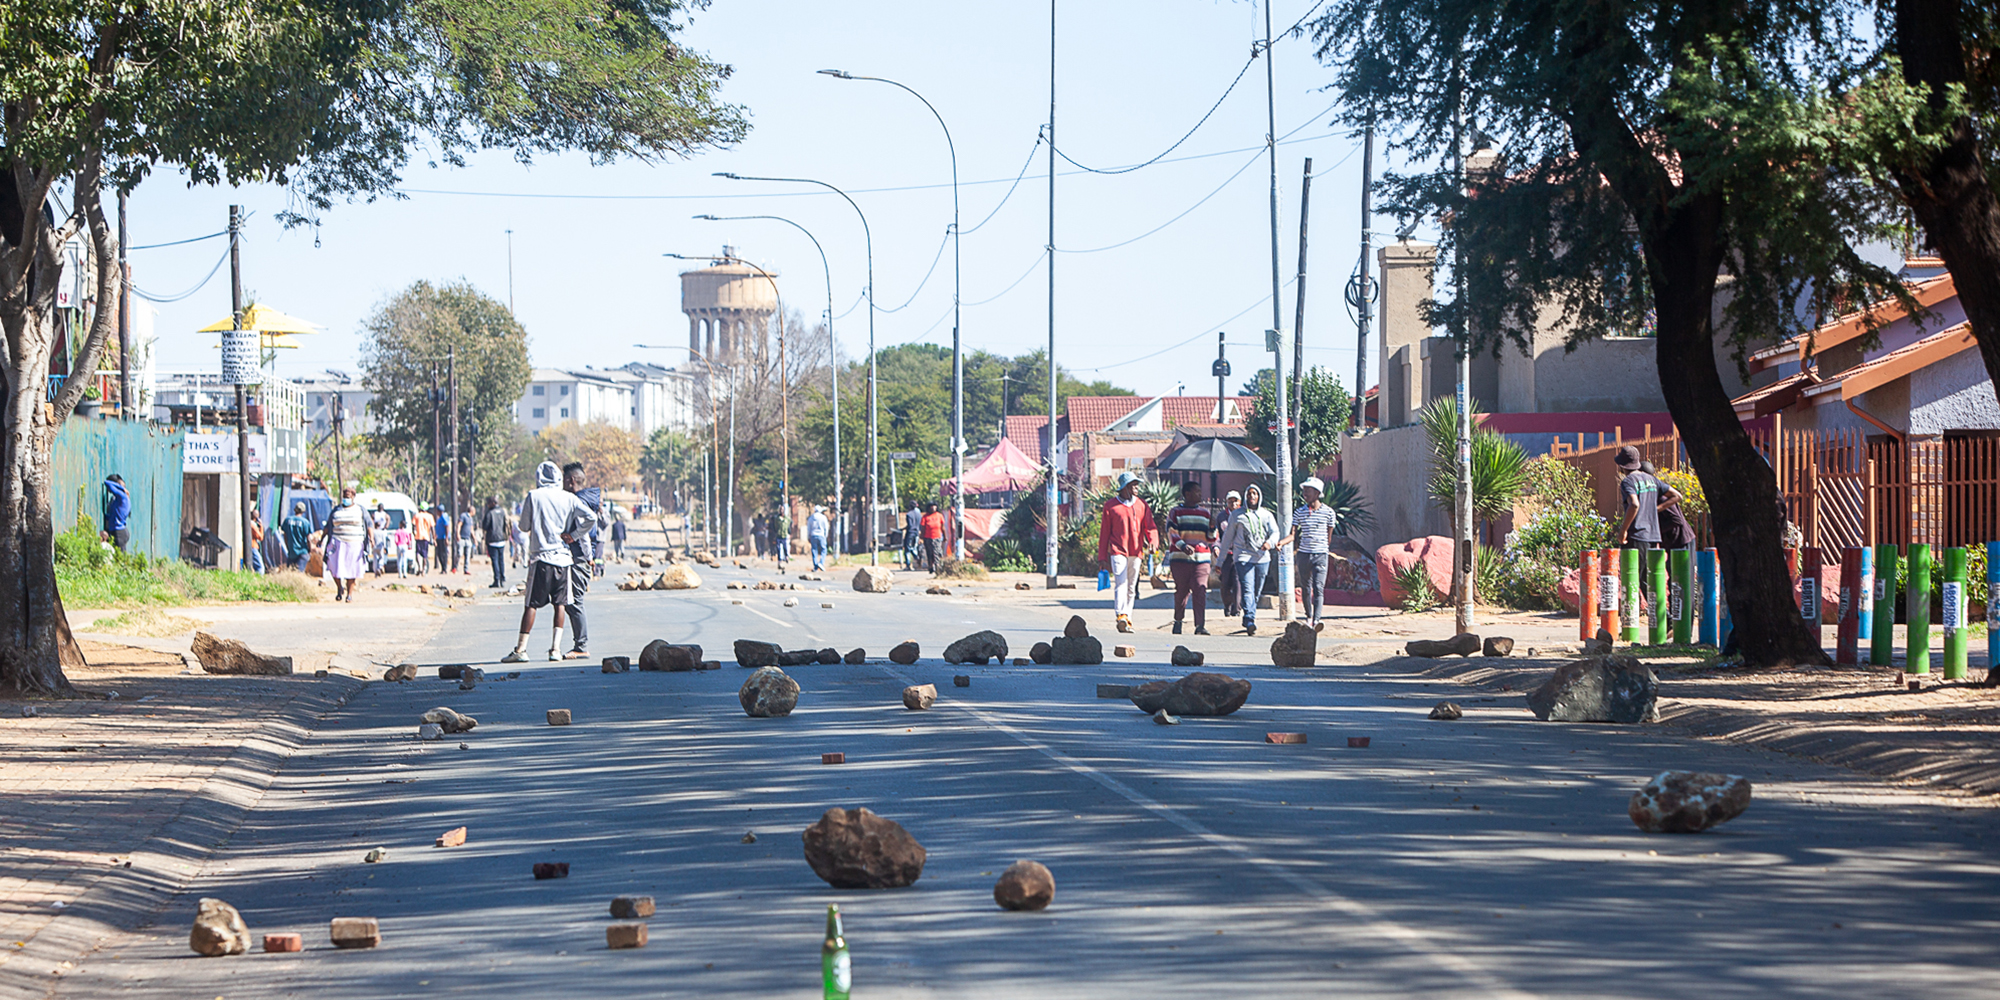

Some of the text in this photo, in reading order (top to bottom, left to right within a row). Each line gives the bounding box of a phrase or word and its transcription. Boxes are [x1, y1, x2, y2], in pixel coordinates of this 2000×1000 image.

[189, 455, 223, 464] STORE
[1802, 580, 1813, 617] ABORTION
[1948, 584, 1956, 626] ABORTION
